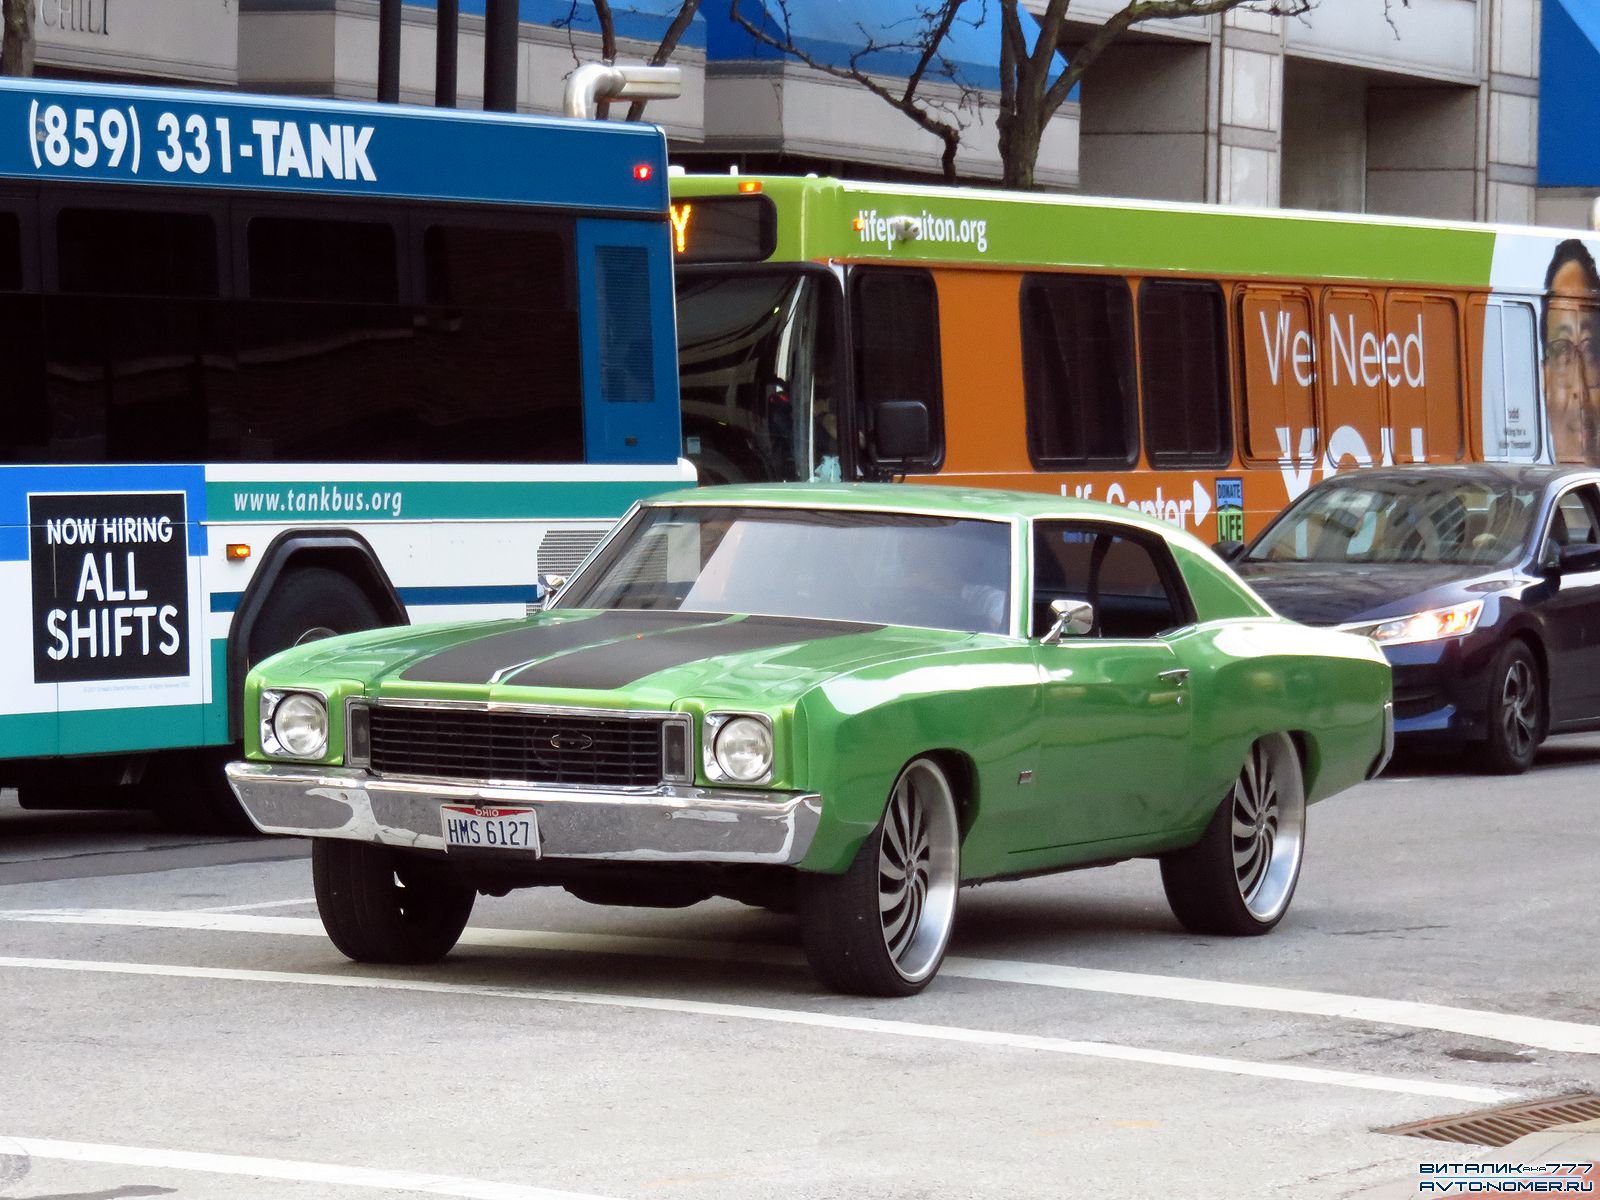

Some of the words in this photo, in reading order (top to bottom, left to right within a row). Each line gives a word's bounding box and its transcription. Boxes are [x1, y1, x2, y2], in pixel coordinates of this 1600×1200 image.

[29, 99, 141, 174] (859)
[156, 112, 377, 182] 331-TANK
[1259, 310, 1317, 386] We
[1330, 314, 1424, 387] Need
[233, 486, 403, 516] www.tankbus.org
[1217, 483, 1242, 499] DONATE
[46, 518, 97, 545] NOW
[103, 516, 173, 545] HIRING
[1218, 514, 1243, 543] LIFE
[76, 552, 149, 603] ALL
[47, 605, 181, 661] SHIFTS
[475, 808, 499, 818] OHIO
[447, 818, 481, 844] HMS
[486, 821, 529, 846] 6127
